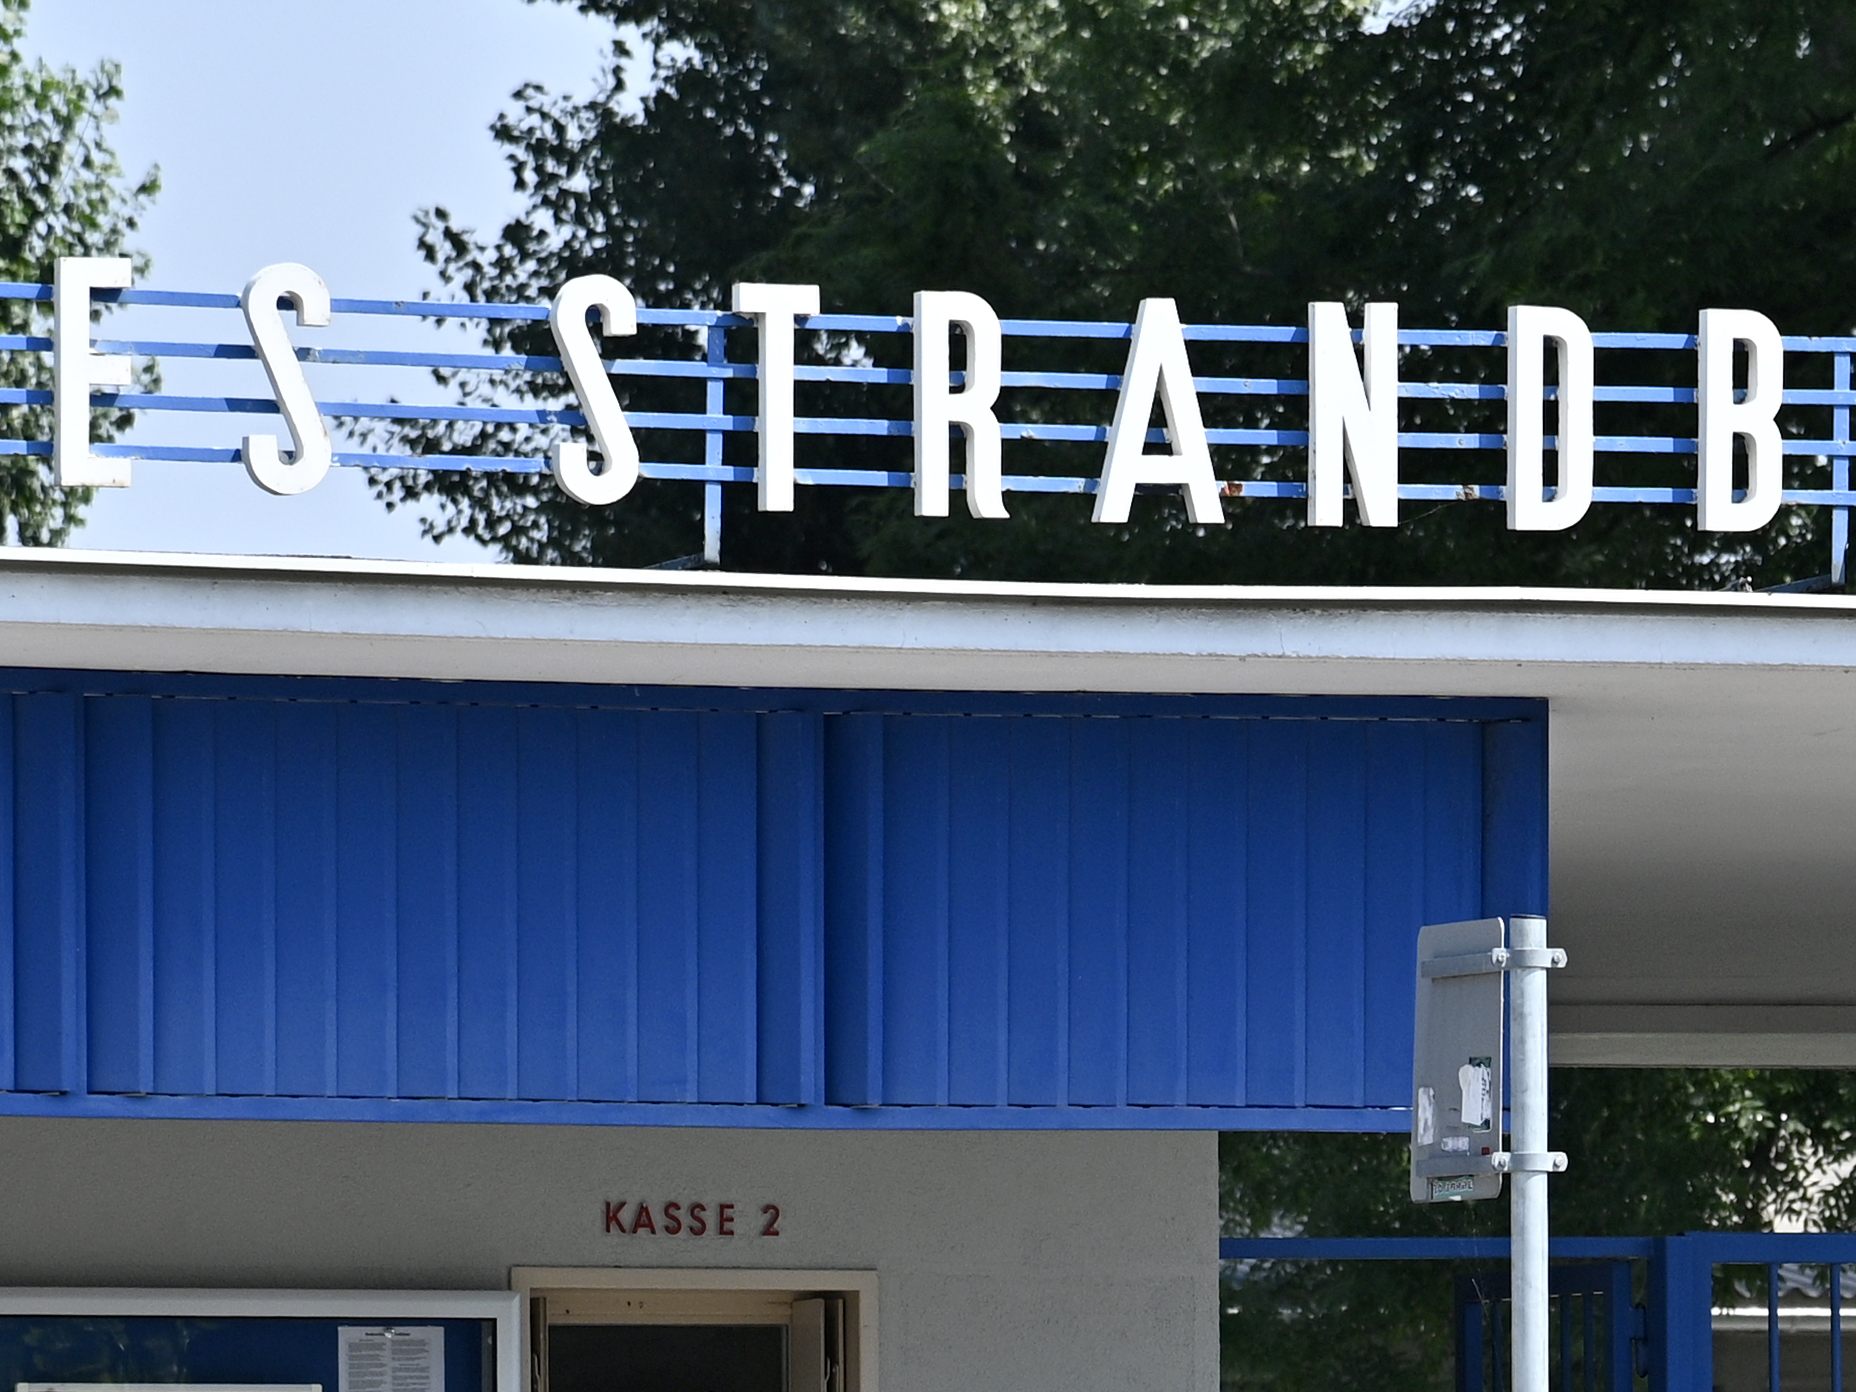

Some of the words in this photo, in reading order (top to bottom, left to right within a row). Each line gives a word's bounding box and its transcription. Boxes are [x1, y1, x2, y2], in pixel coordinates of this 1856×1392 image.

[54, 257, 331, 496] ES
[604, 1200, 735, 1237] KASSE
[760, 1203, 781, 1237] 2
